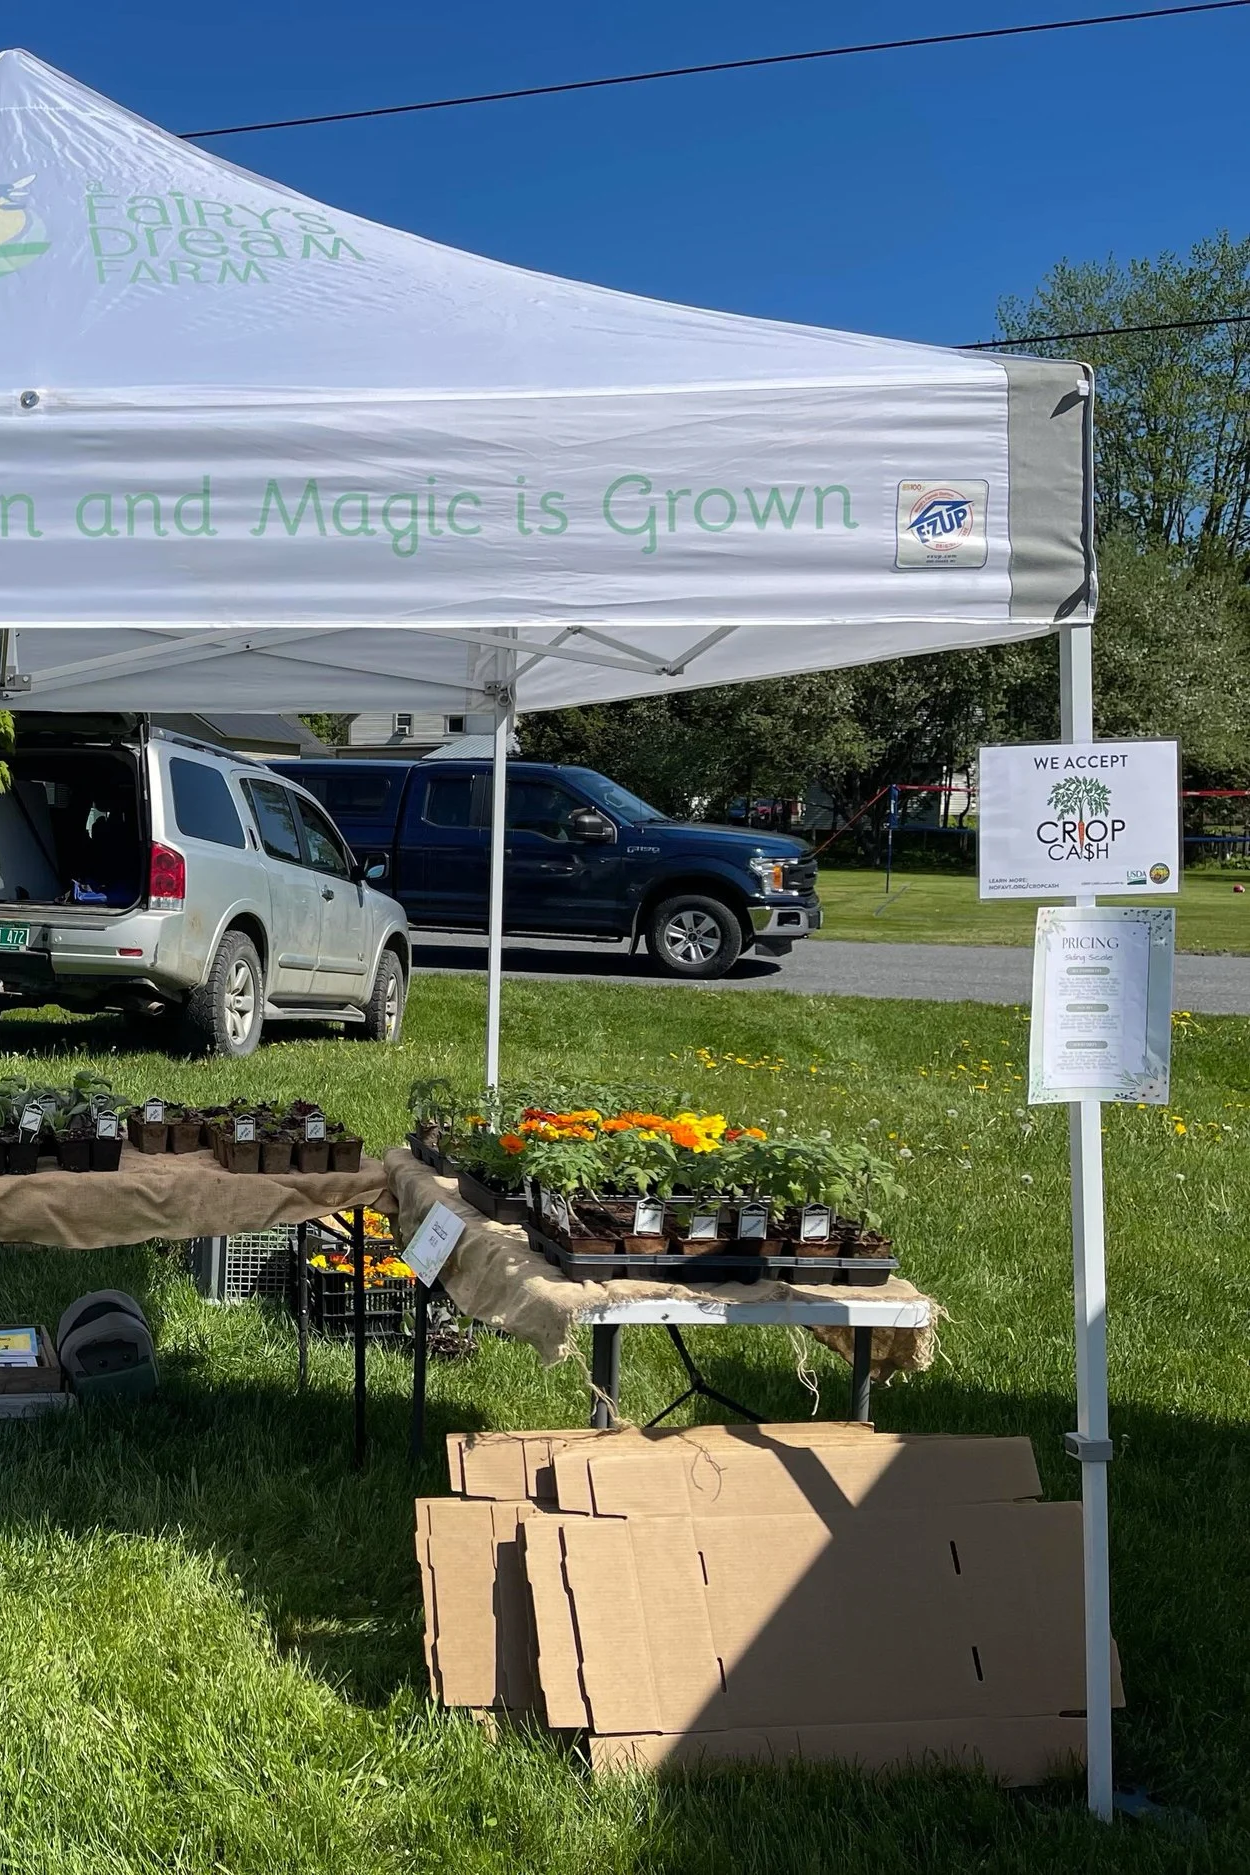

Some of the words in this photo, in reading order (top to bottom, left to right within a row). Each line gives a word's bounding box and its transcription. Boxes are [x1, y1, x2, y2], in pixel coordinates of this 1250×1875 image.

[96, 259, 271, 285] FARM
[75, 475, 219, 537] and
[250, 475, 483, 558] Magic
[515, 475, 569, 536] is
[603, 474, 860, 555] Grown
[1033, 756, 1059, 770] WE
[1063, 754, 1128, 769] ACCEPT
[1037, 819, 1126, 845] CROP
[1126, 870, 1147, 878] USDA
[6, 930, 25, 944] 472
[1062, 936, 1119, 949] PRICING
[1088, 953, 1113, 961] Scale
